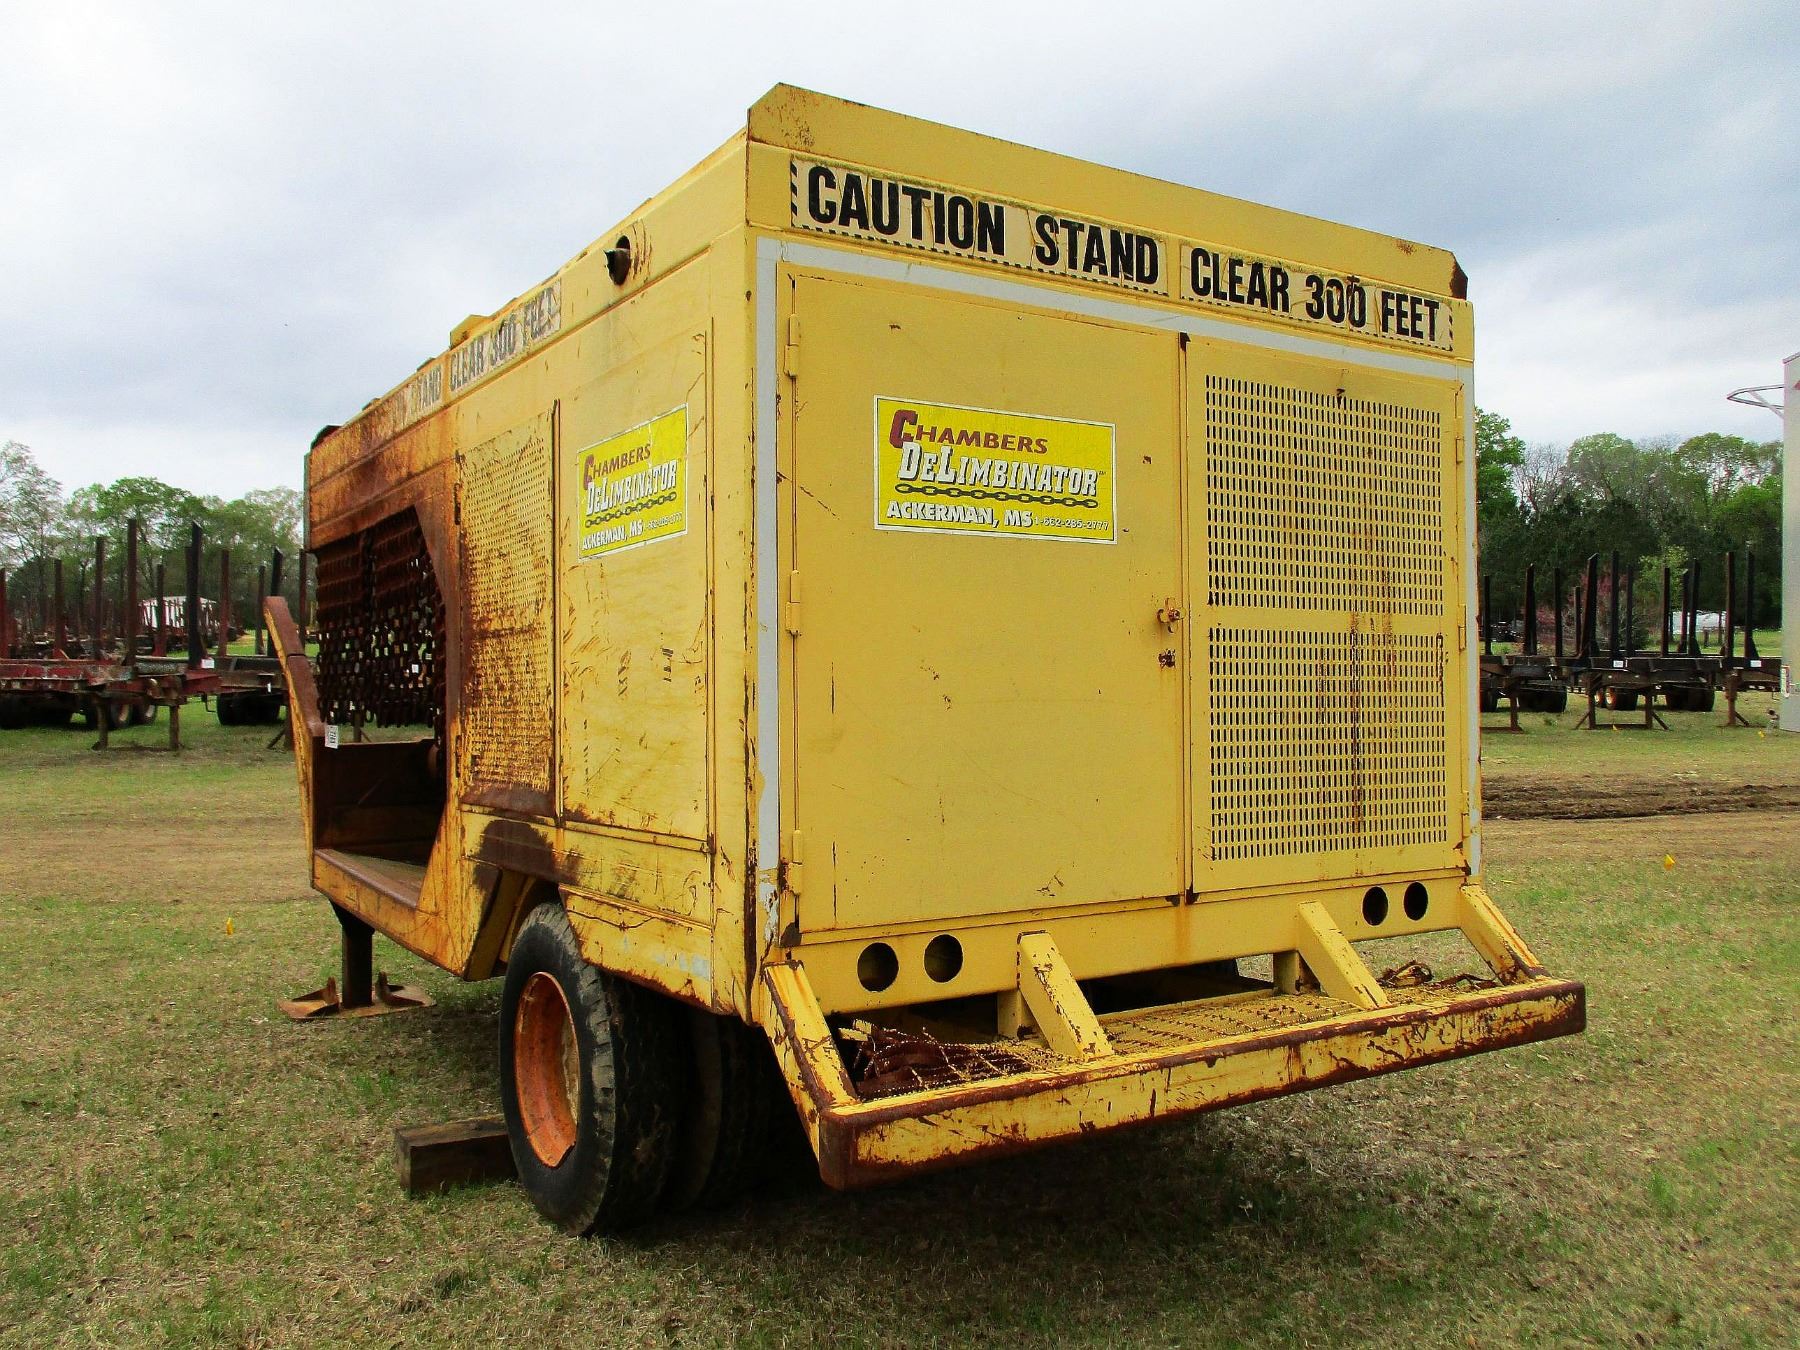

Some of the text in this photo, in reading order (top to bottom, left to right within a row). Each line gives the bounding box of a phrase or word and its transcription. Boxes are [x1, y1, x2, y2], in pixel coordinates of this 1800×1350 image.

[806, 165, 1159, 286] CAUTION STAND
[1190, 247, 1440, 343] CLEAR 300 FEET
[889, 409, 1049, 455] CHAMBERS
[583, 443, 651, 491] CHAMBERS
[581, 524, 628, 551] ACKERMAN,
[629, 519, 644, 538] MS
[886, 500, 1000, 528] ACKERMAN,
[1004, 509, 1034, 528] MS
